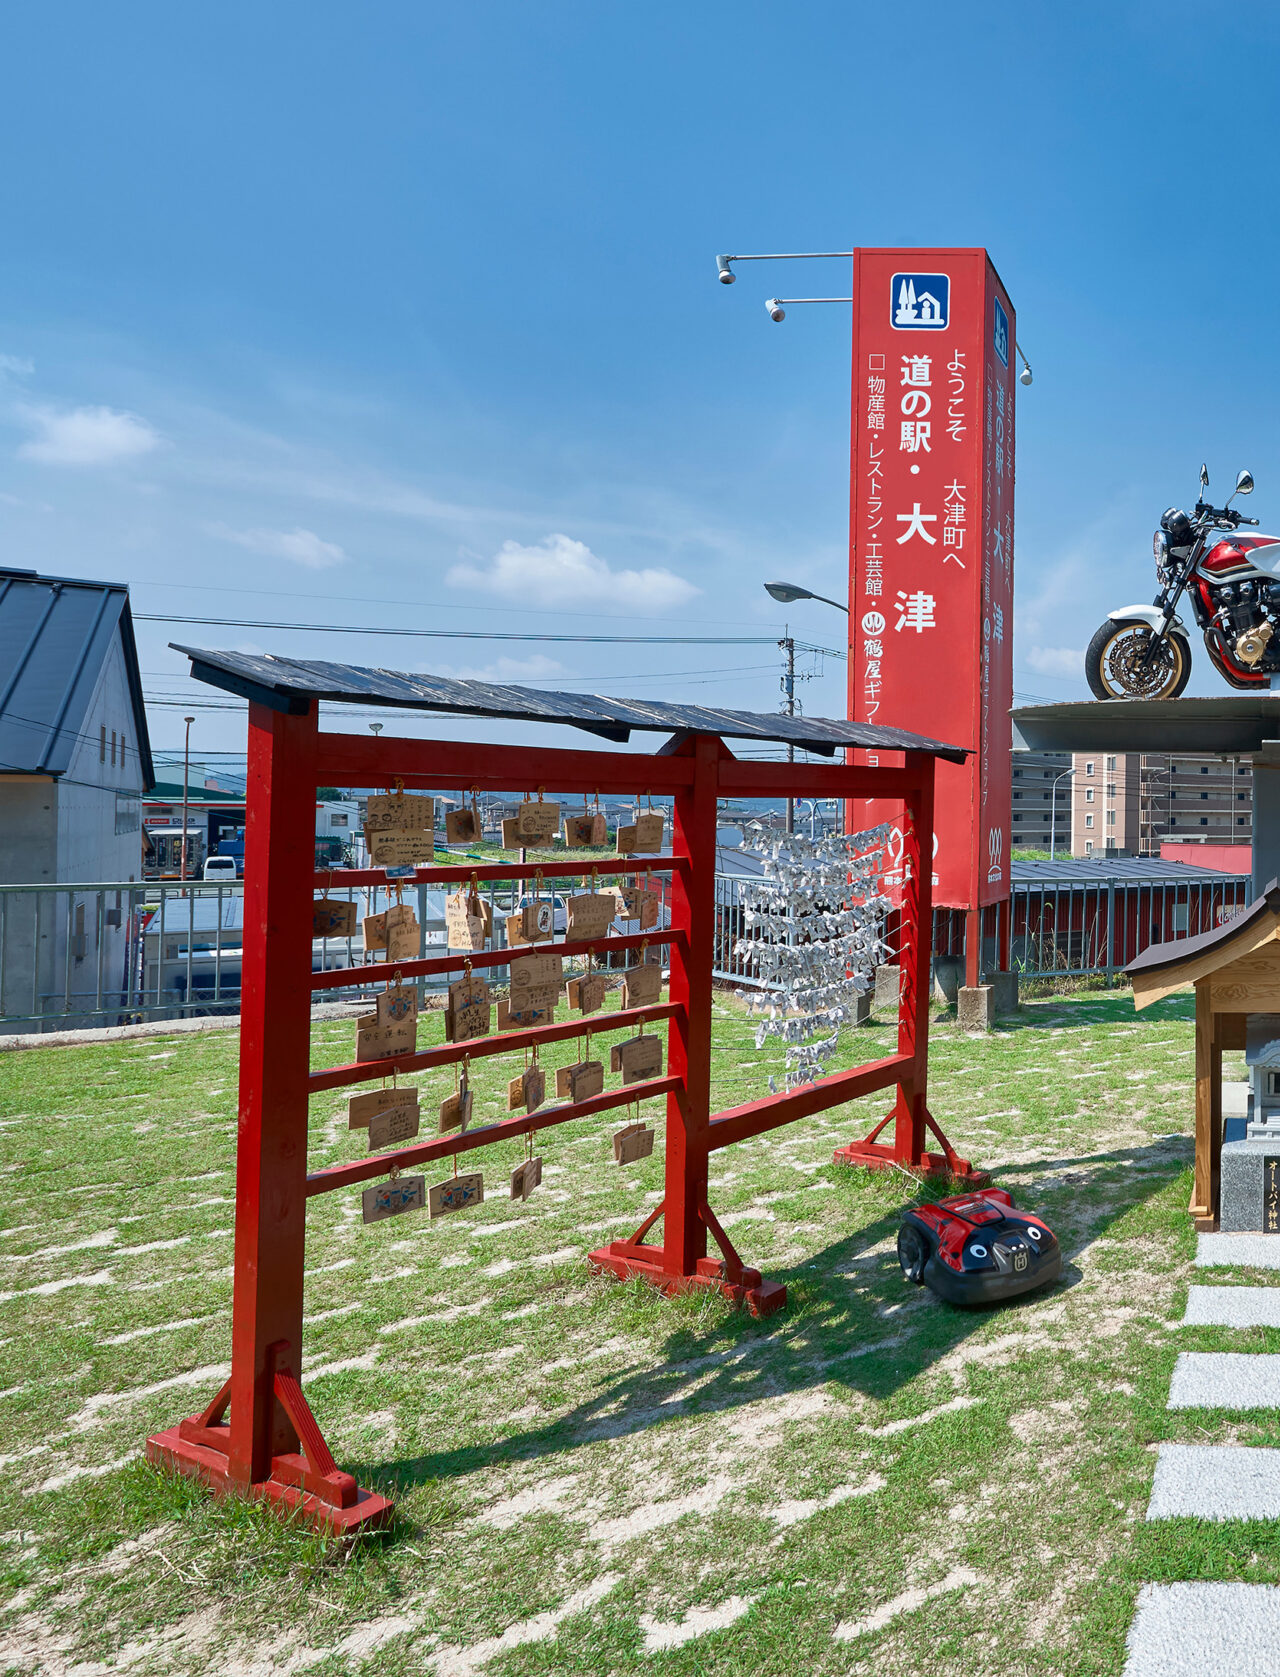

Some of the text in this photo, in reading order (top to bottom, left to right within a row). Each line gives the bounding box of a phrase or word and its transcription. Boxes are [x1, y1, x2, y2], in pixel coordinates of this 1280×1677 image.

[942, 349, 968, 569] ようこそ 大津町へ
[1268, 1160, 1278, 1230] オートバイ神社
